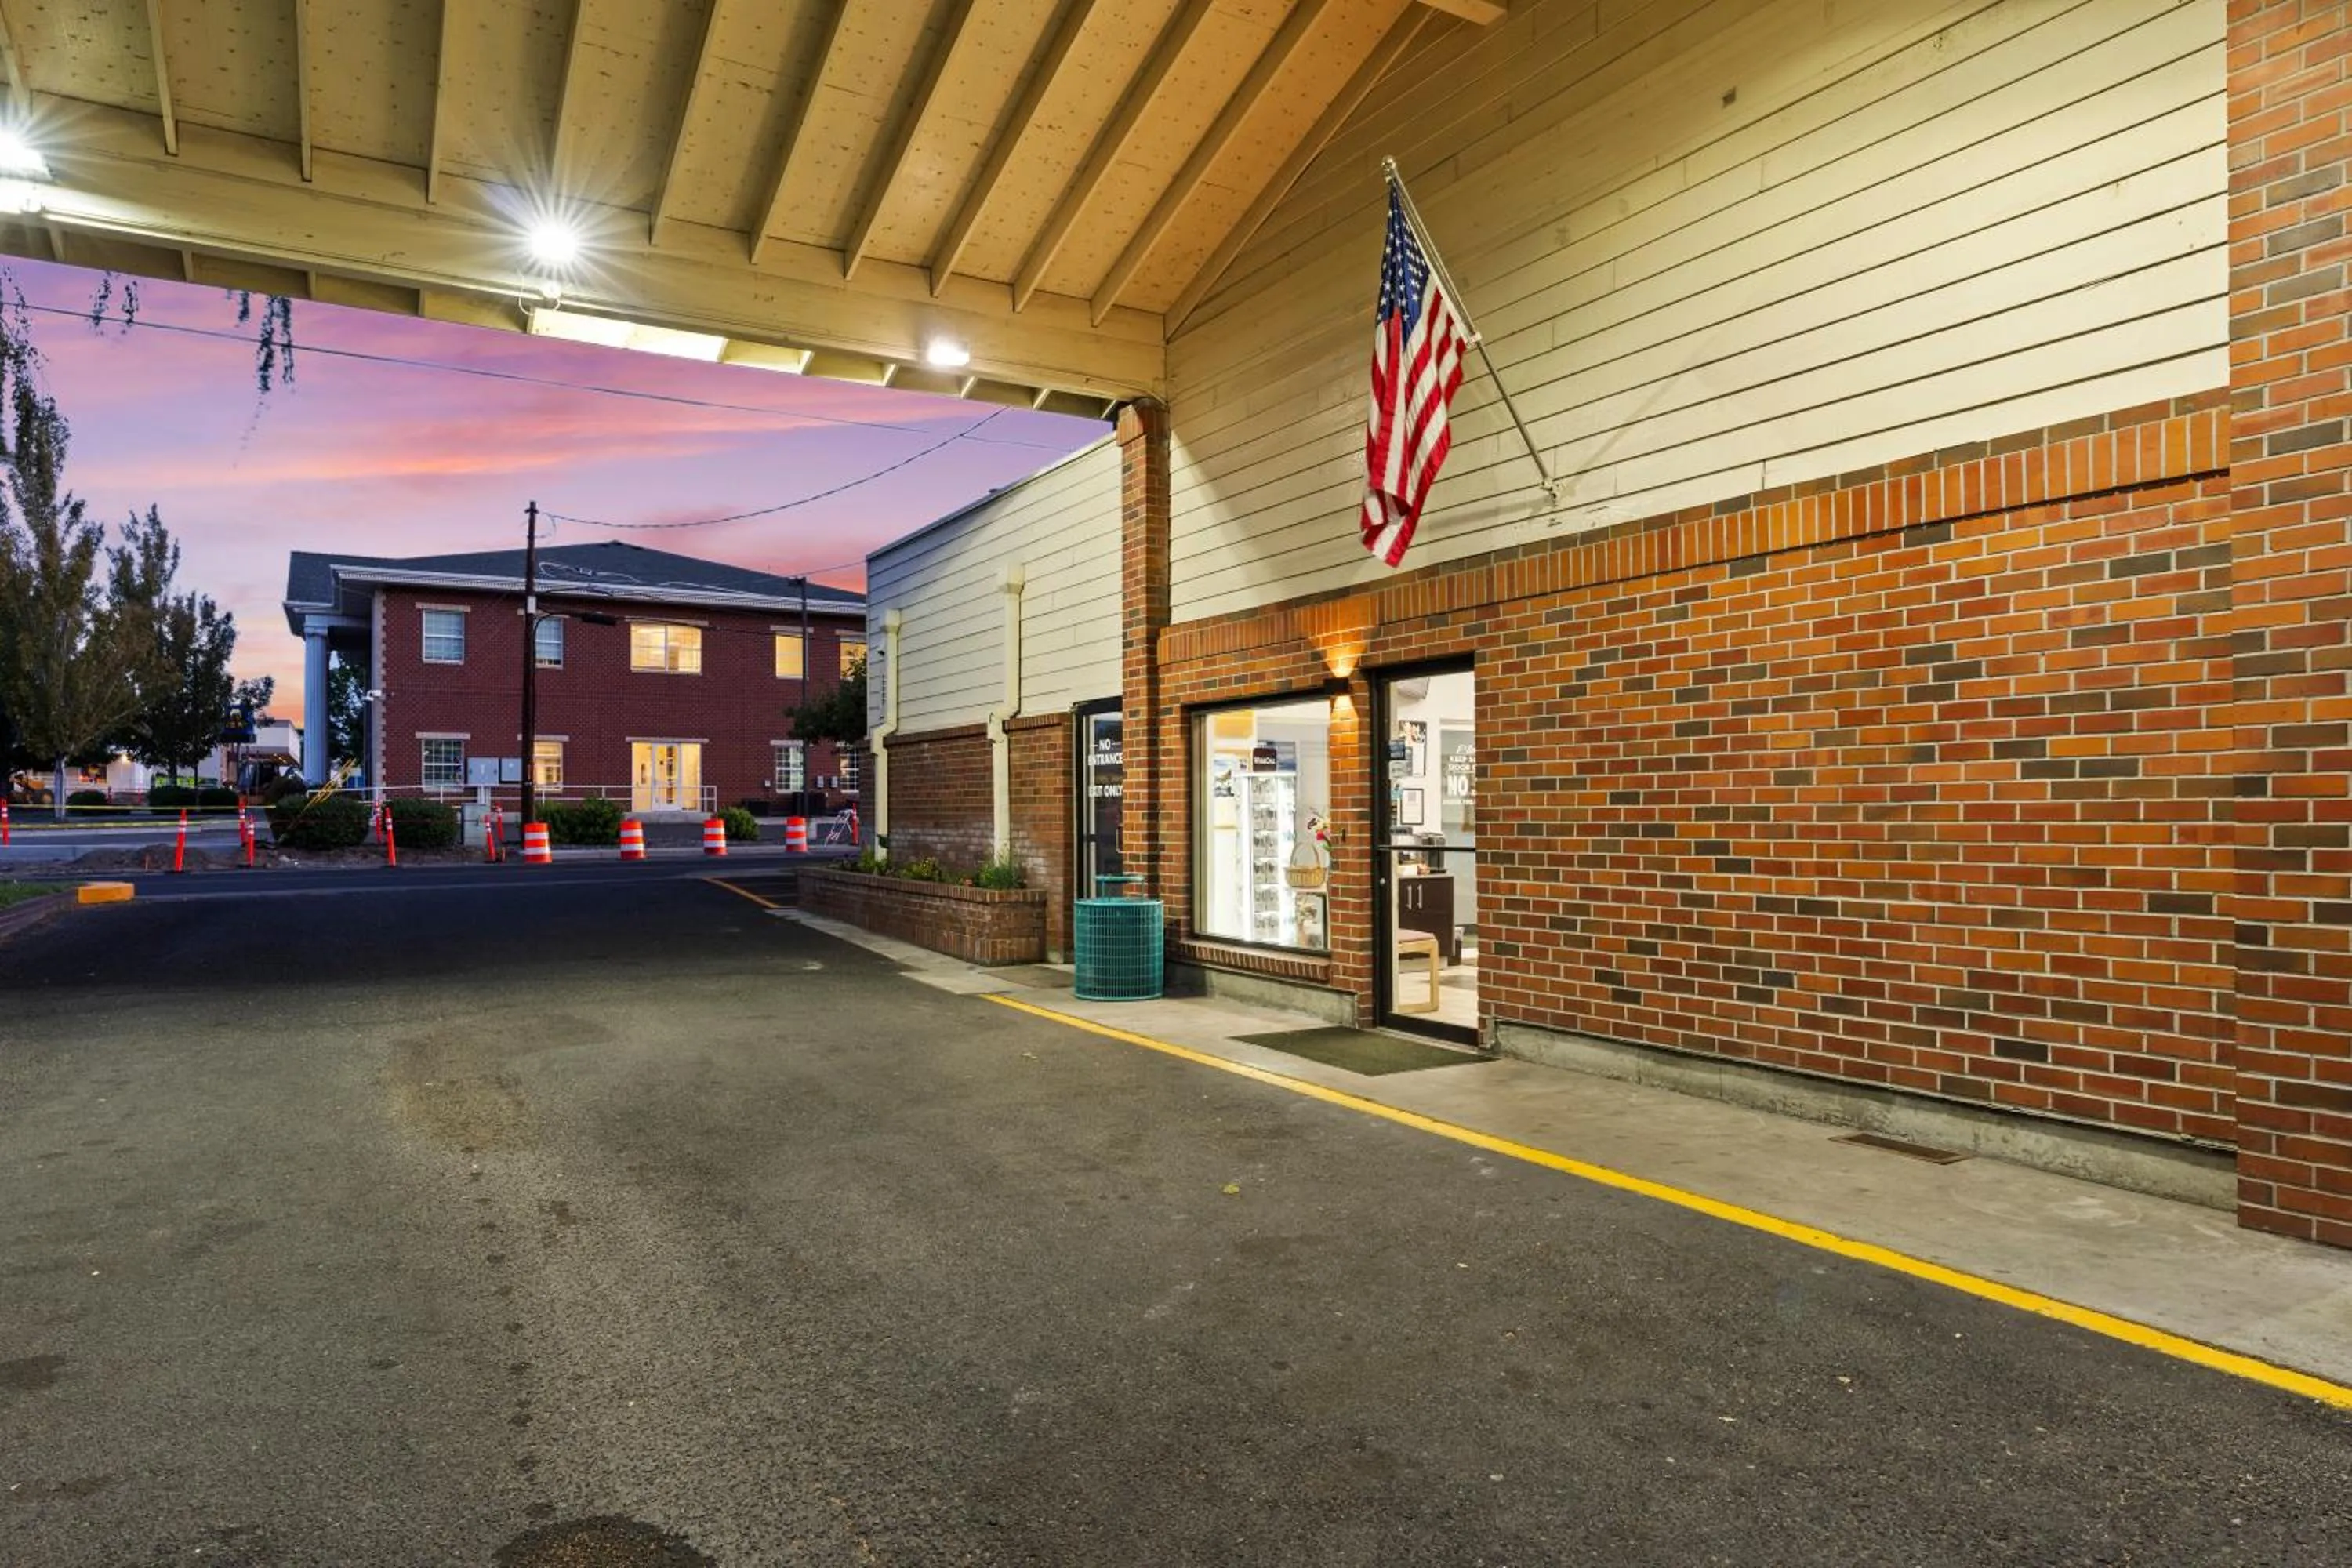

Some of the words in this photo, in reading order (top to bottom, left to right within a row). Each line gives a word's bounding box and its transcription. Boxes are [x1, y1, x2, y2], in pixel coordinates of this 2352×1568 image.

[1099, 739, 1111, 750] NO
[1088, 753, 1123, 765] ENTRANCE
[1104, 785, 1123, 797] ONLY
[1447, 775, 1468, 797] NO
